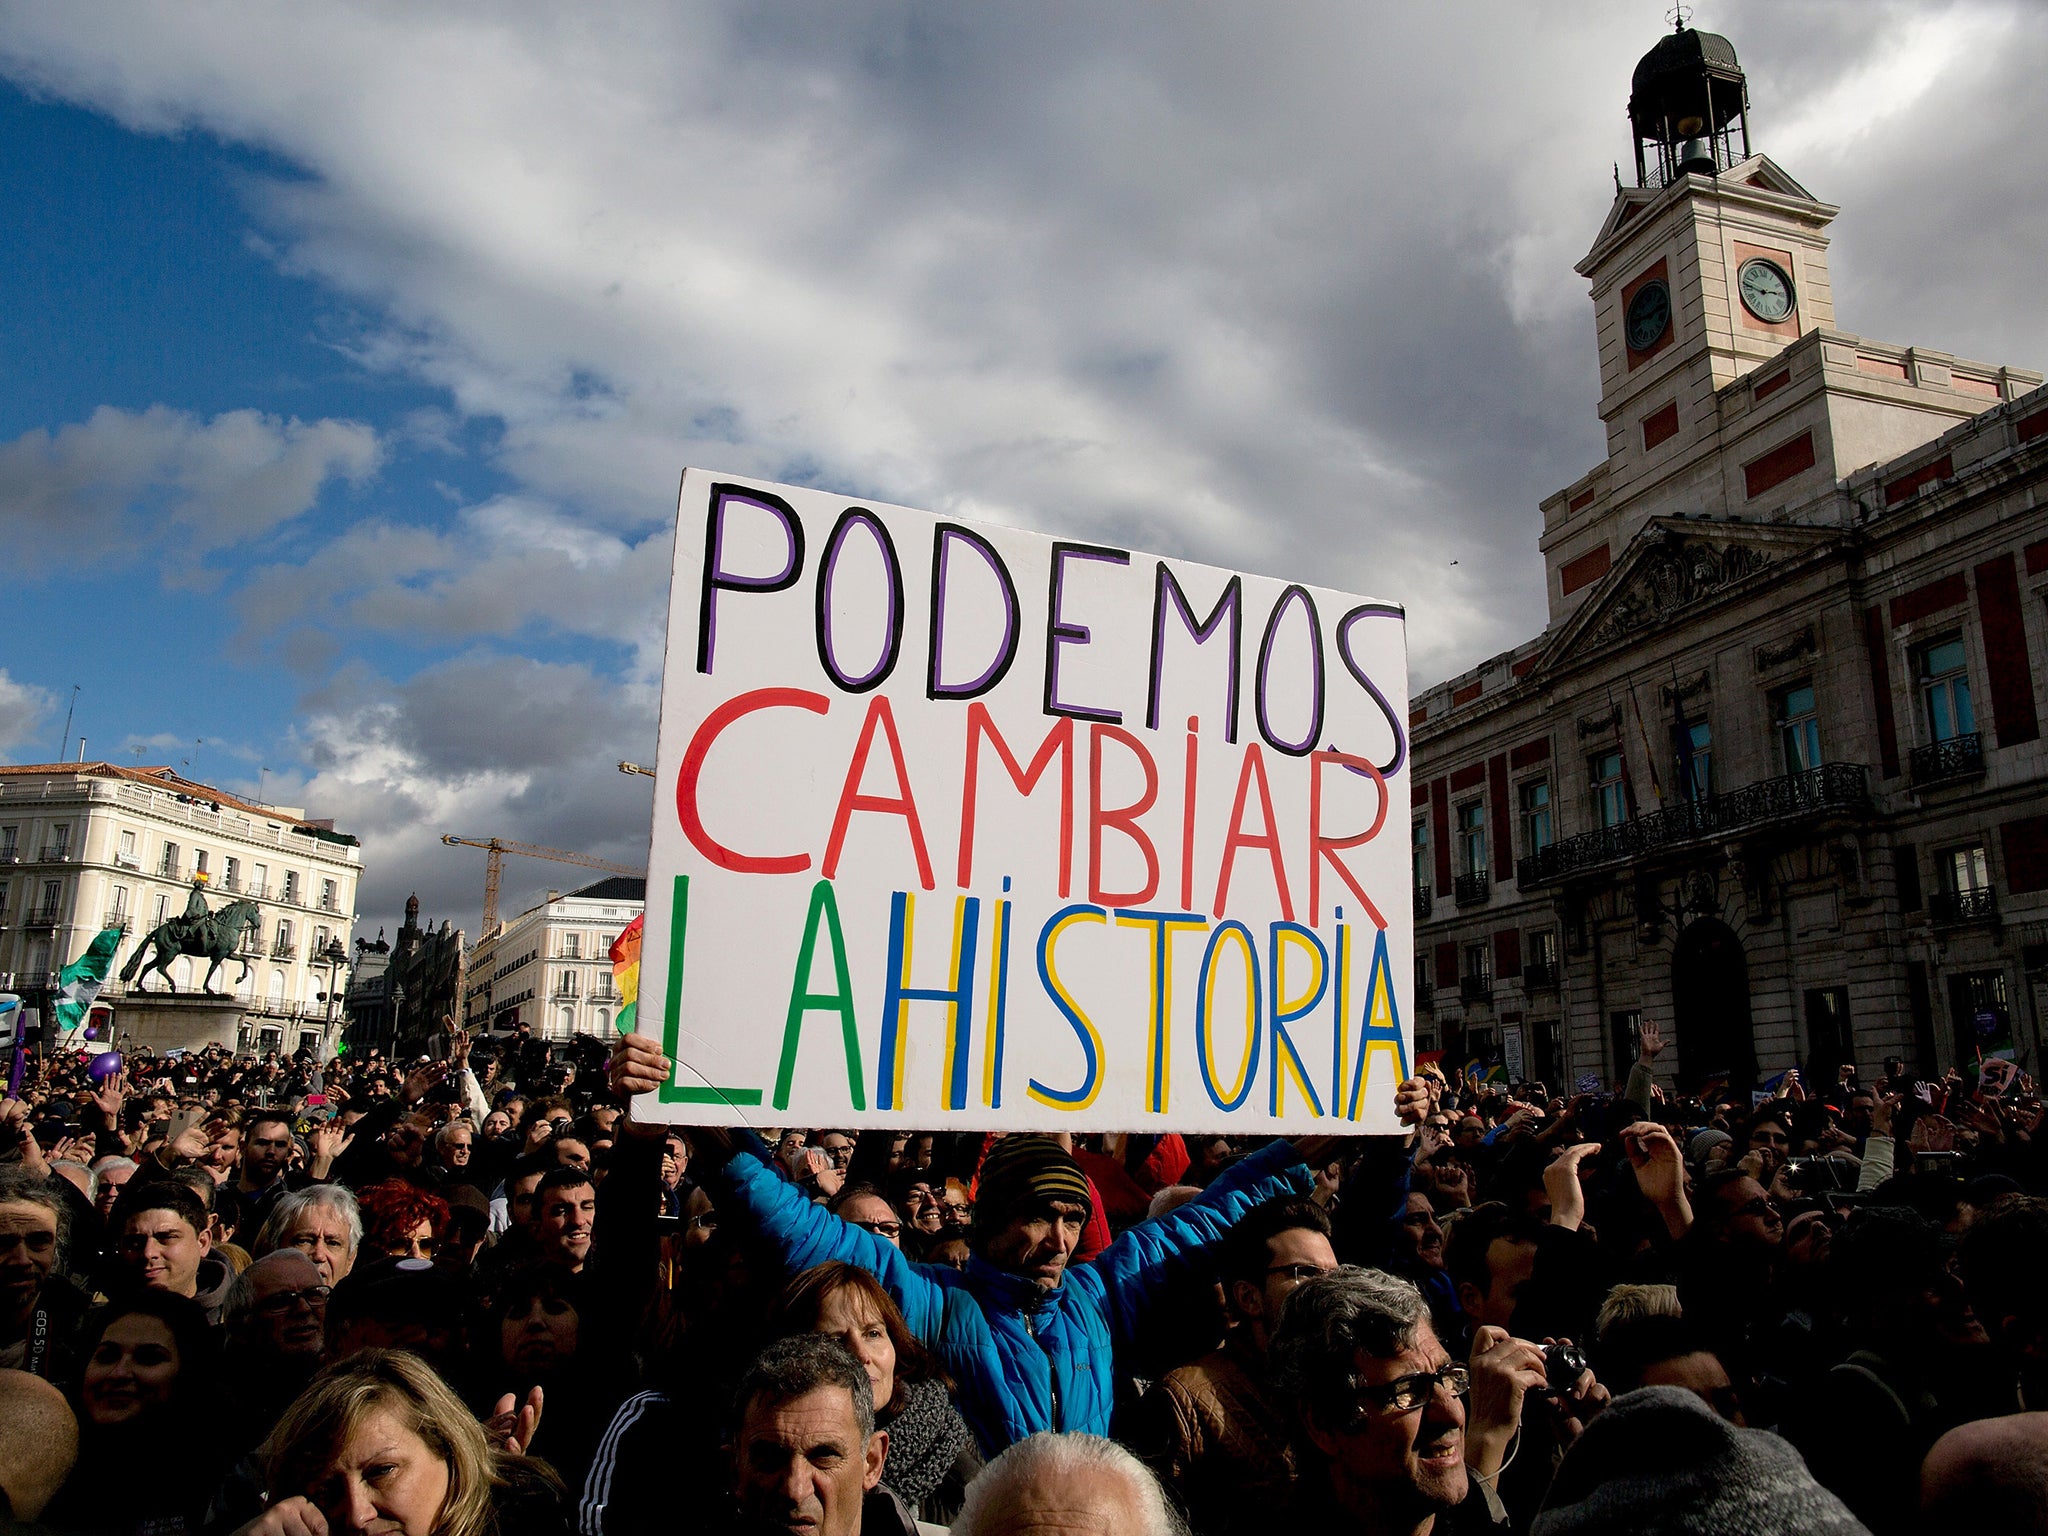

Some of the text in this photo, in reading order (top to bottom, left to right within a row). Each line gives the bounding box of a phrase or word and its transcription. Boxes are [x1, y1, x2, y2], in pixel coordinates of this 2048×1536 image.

[696, 483, 1406, 779] PODEMOS
[659, 875, 865, 1111] LA
[33, 1339, 45, 1354] 5D
[35, 1310, 47, 1336] EOS
